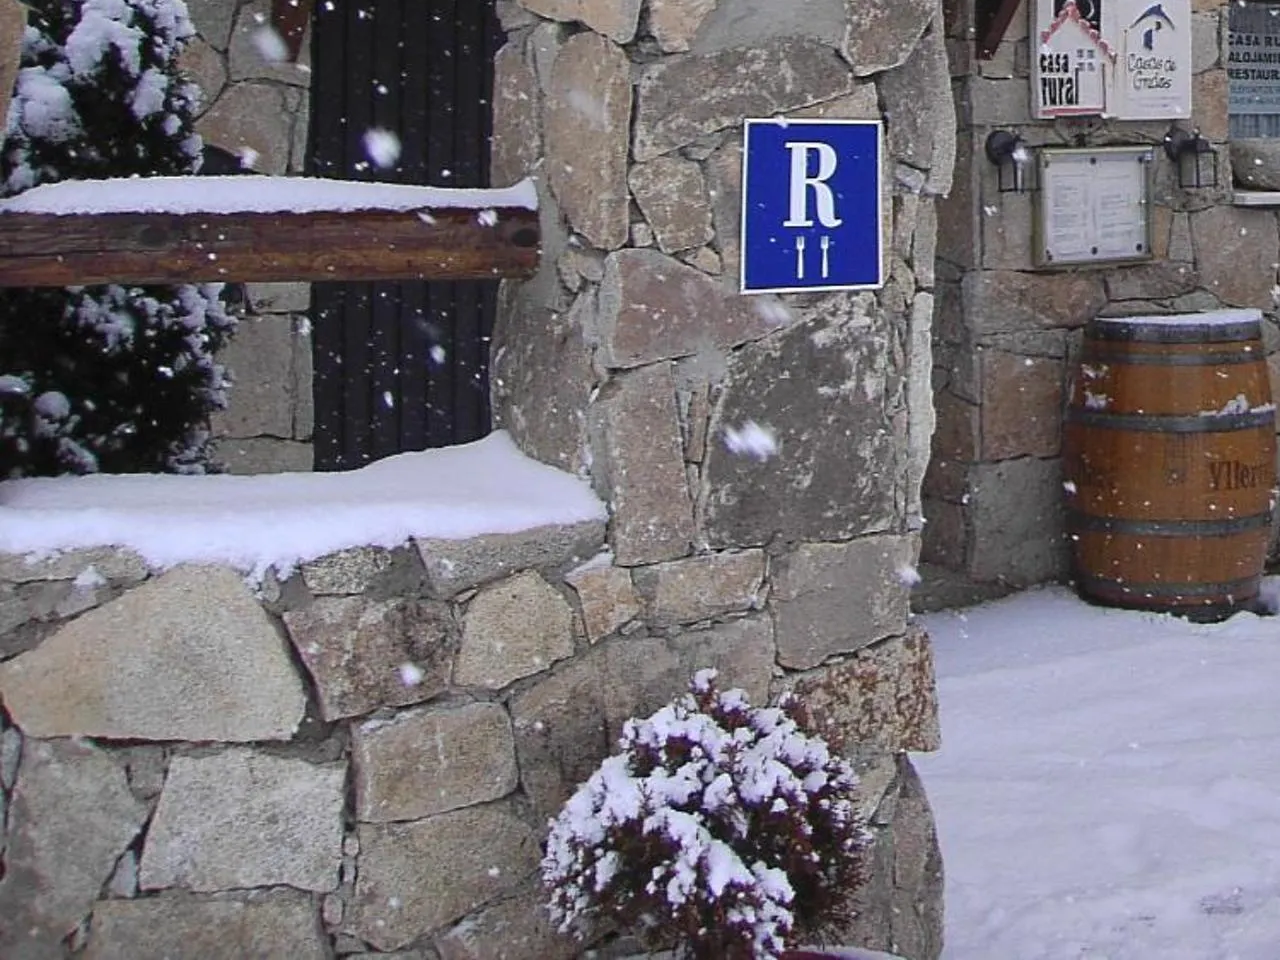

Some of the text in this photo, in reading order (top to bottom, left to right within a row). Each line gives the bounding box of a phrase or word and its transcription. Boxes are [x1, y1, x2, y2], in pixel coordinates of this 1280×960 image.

[1228, 33, 1260, 47] CASA
[1039, 52, 1070, 74] casa
[1040, 67, 1080, 106] rural
[782, 141, 843, 228] R
